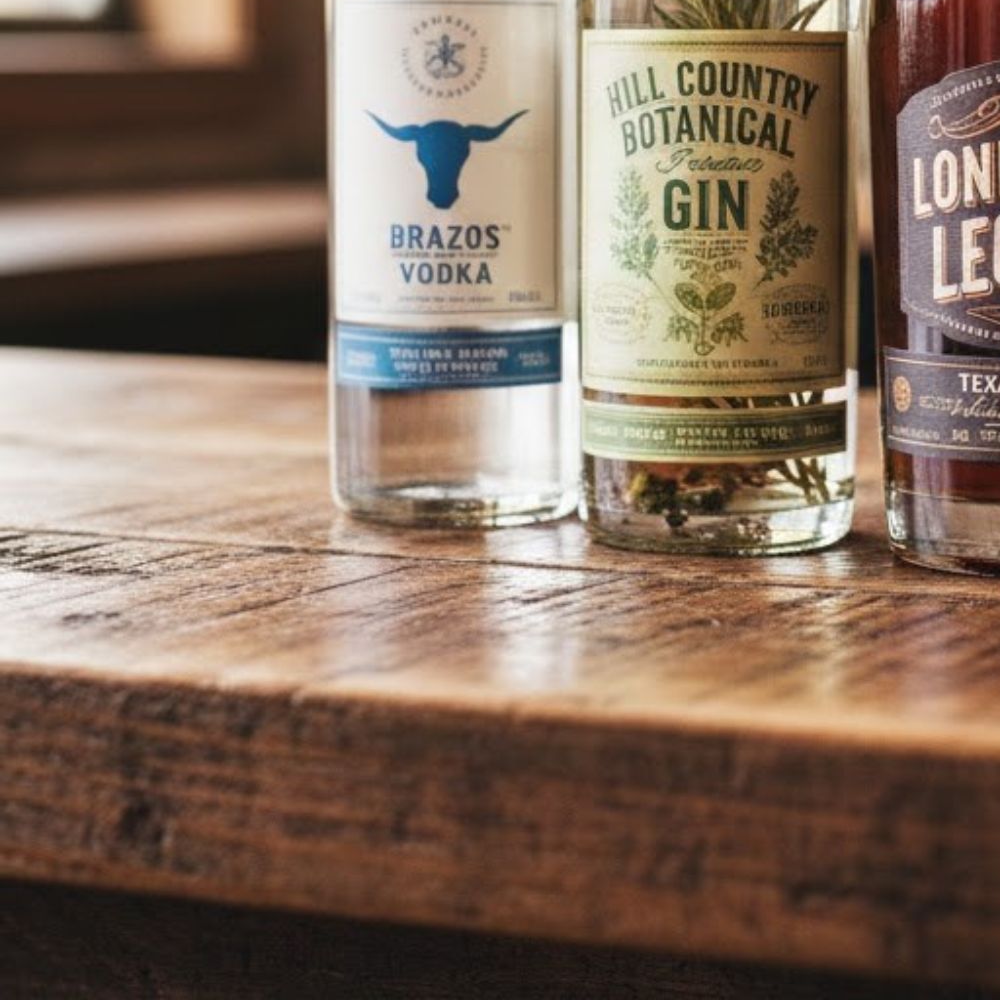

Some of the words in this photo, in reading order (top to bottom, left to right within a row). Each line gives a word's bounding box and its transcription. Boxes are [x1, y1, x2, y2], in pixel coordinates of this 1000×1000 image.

[606, 66, 665, 118] HILL
[677, 60, 820, 115] COUNTRY
[621, 105, 795, 158] BOTANICAL
[663, 179, 749, 231] GIN
[390, 224, 500, 250] BRAZOS
[400, 262, 493, 284] VODKA
